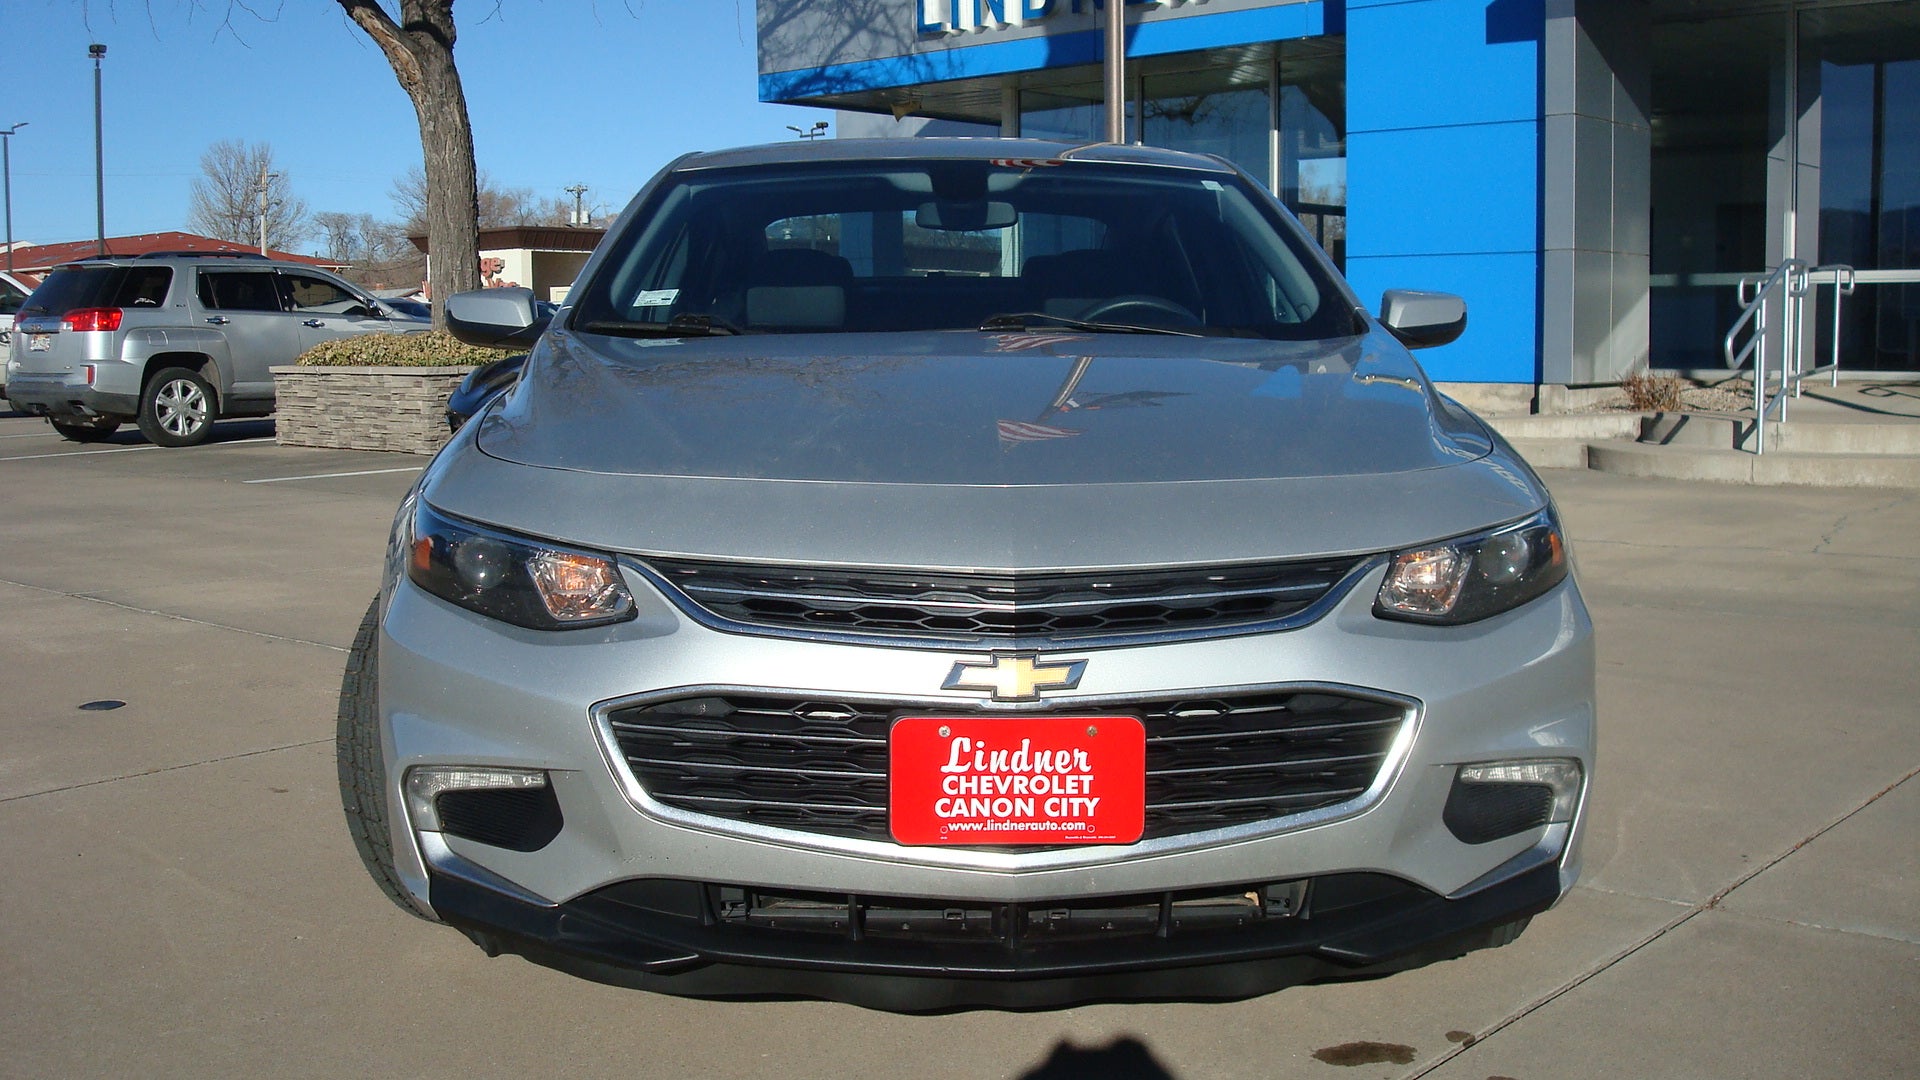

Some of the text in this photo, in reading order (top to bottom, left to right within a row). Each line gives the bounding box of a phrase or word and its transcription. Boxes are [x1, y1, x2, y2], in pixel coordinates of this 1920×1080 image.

[916, 0, 1207, 32] LIND
[940, 736, 1092, 773] Lindner
[943, 775, 1093, 795] CHEVROLET
[935, 797, 1100, 817] CANON CITY
[948, 819, 1085, 831] www.lindnerauto.com
